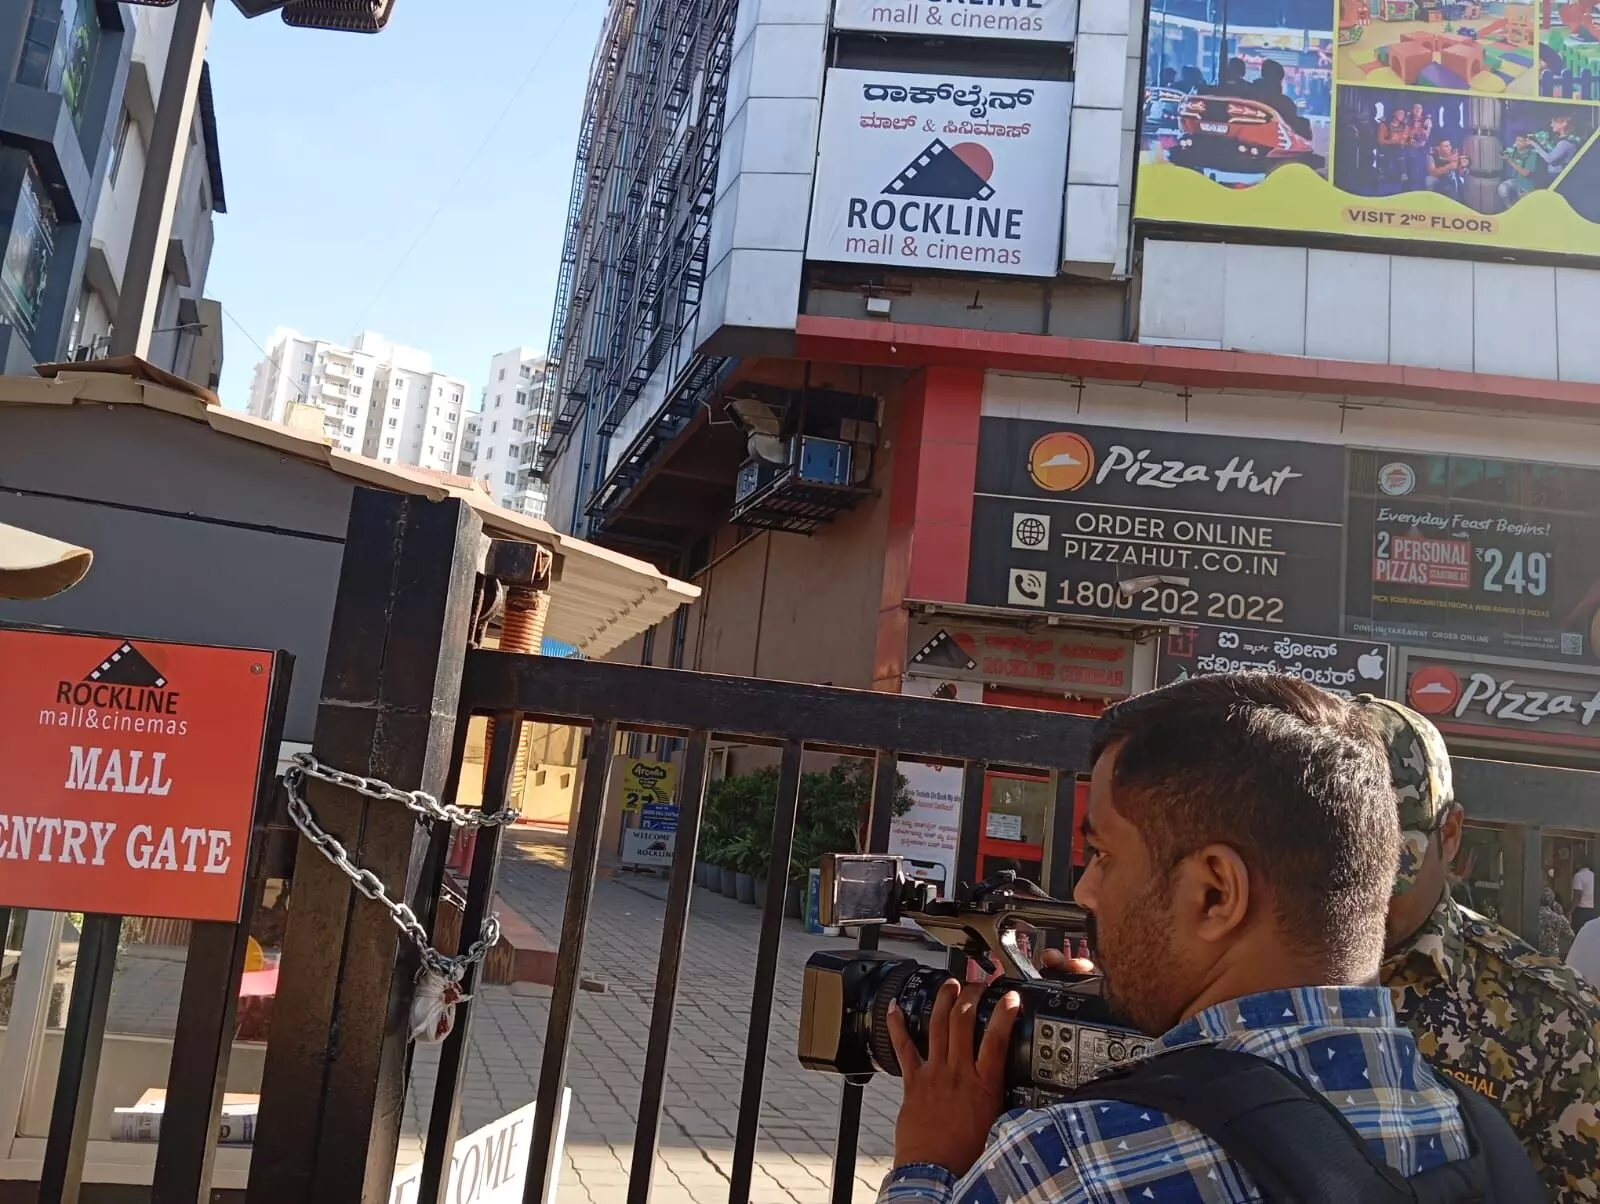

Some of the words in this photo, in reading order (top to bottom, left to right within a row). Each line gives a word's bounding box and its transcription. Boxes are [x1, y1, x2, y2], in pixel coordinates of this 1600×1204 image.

[872, 6, 918, 26] mall
[926, 7, 944, 26] &
[951, 10, 1043, 31] cinemas
[860, 112, 917, 130] ಮಾಲ್
[922, 118, 937, 133] &
[847, 198, 1023, 240] ROCKLINE
[1348, 209, 1395, 224] VISIT
[1431, 216, 1492, 232] FLOOR
[845, 235, 894, 255] mall
[900, 236, 919, 257] &
[926, 238, 1021, 265] cinemas
[1096, 445, 1210, 489] Pizza
[1214, 456, 1303, 496] Hut
[1075, 512, 1165, 539] ORDER
[1173, 520, 1273, 548] ONLINE
[1376, 507, 1449, 529] Everyday
[1452, 514, 1495, 530] Feast
[1496, 518, 1551, 536] Begins!
[1064, 540, 1278, 576] PIZZAHUT.CO.IN
[1376, 531, 1390, 558] 2
[1394, 539, 1469, 565] PERSONAL
[1376, 559, 1428, 584] PIZZAS
[1057, 579, 1133, 609] 1800
[1141, 587, 1200, 615] 202
[1207, 593, 1284, 623] 2022
[56, 680, 180, 715] ROCKLINE
[1455, 672, 1575, 722] Pizza
[65, 745, 173, 796] MALL
[126, 824, 233, 875] GATE
